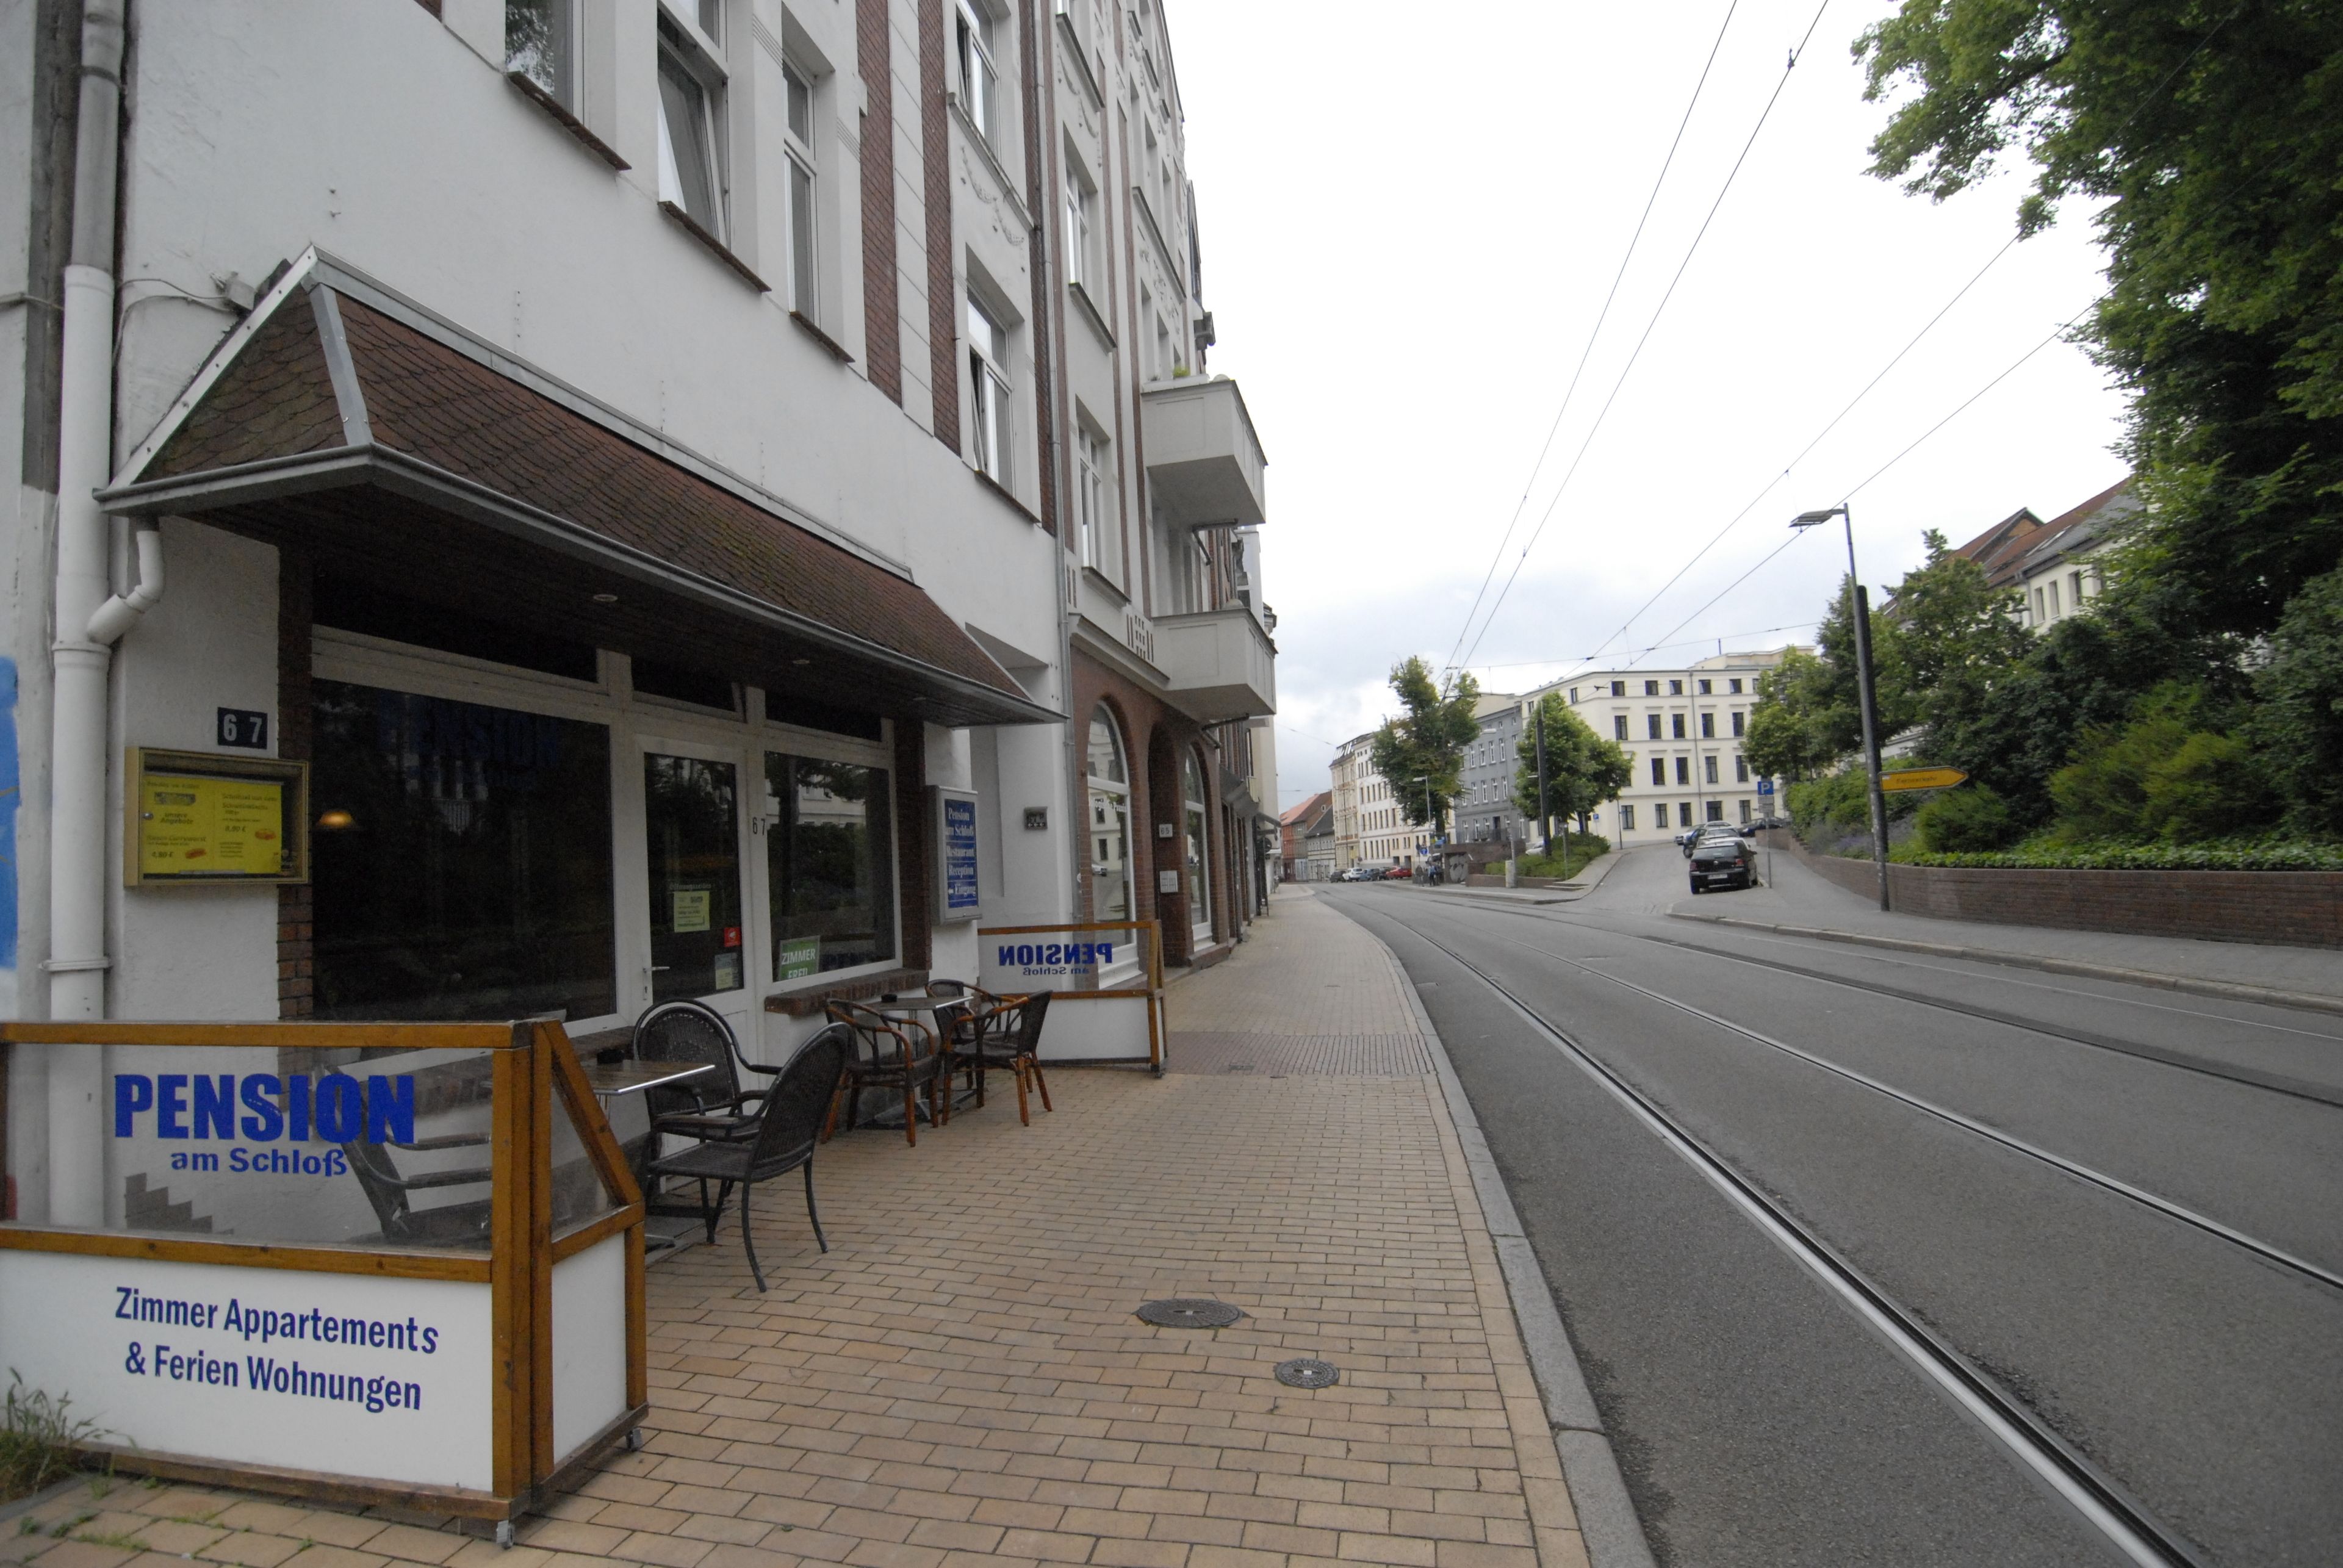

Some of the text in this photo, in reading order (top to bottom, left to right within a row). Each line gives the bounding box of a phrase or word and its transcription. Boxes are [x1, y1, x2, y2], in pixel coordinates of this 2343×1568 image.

[223, 713, 262, 743] 67
[1761, 783, 1769, 794] P
[948, 807, 970, 821] Pension
[752, 817, 765, 835] 67
[955, 825, 974, 836] Schloß
[946, 845, 974, 857] Restaurant
[949, 865, 974, 878] Reception
[954, 883, 976, 897] Eingang
[781, 948, 816, 965] ZIMMER
[114, 1073, 416, 1145] PENSION
[171, 1147, 348, 1178] am Schloß
[115, 1286, 439, 1354] Zimmer Appartements
[125, 1342, 422, 1413] & Ferien Wohnungen
